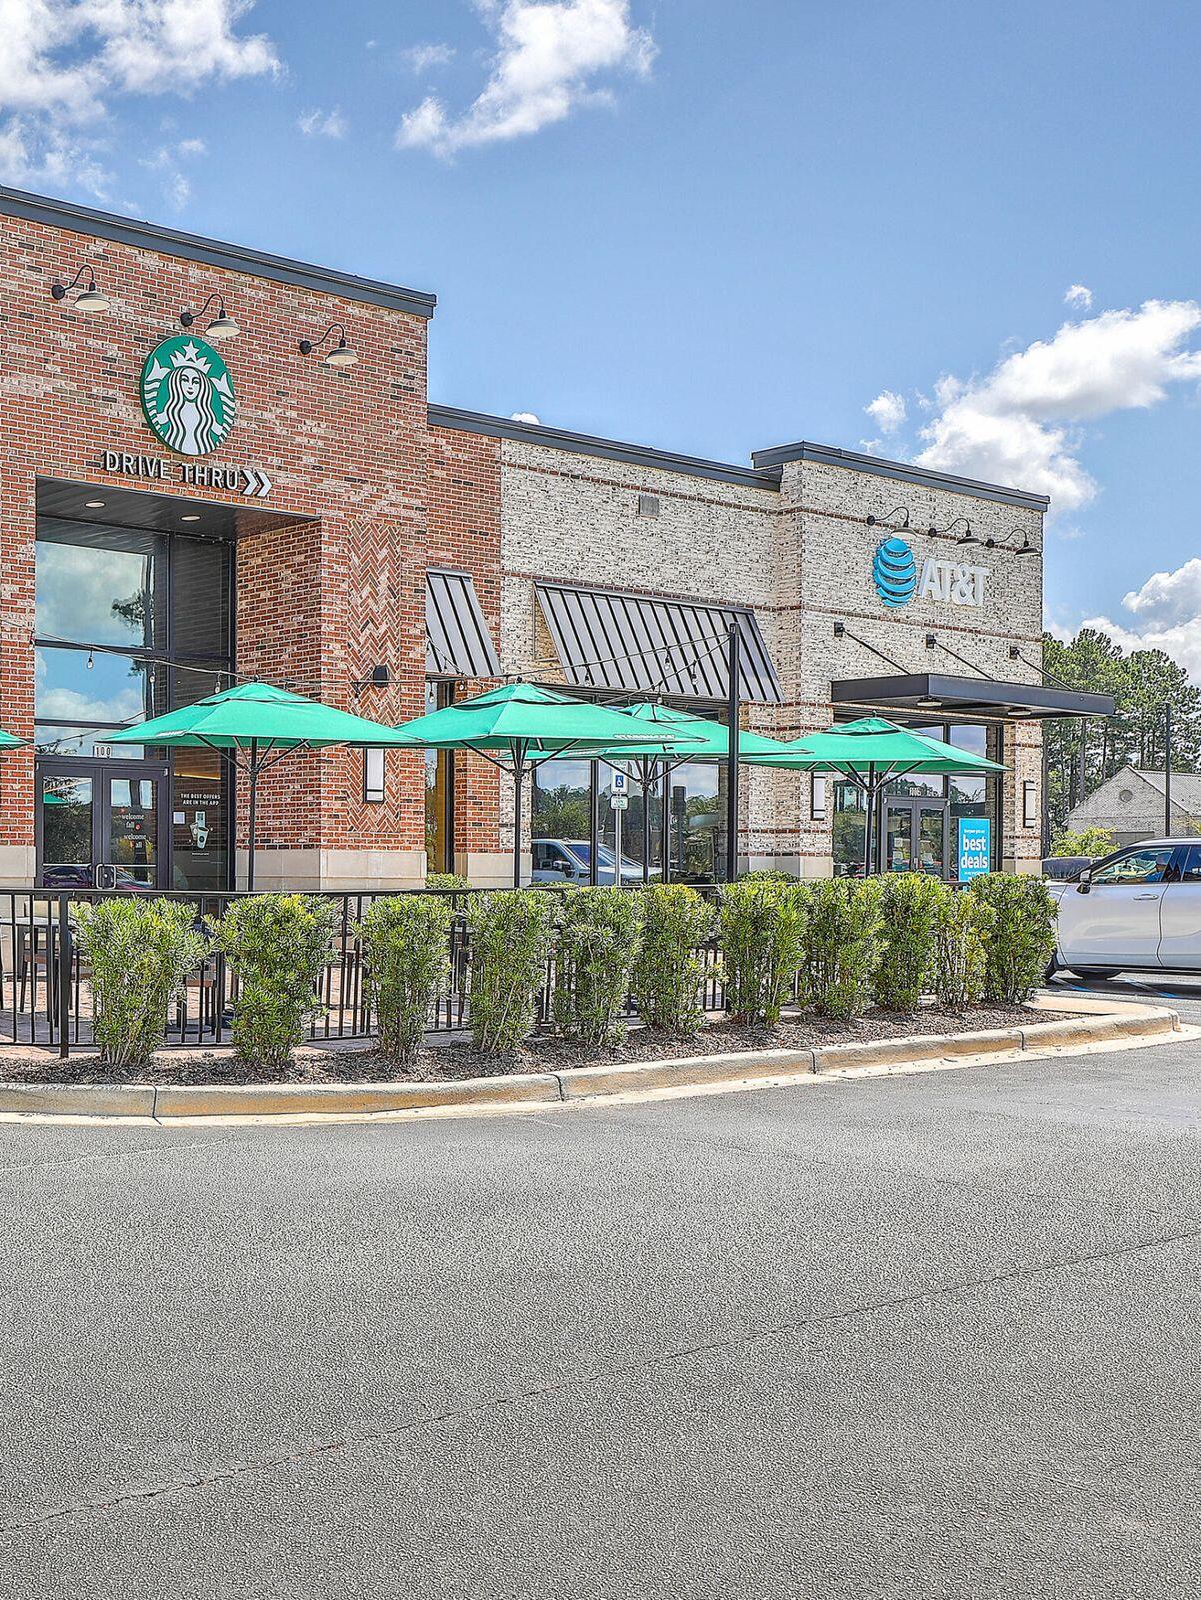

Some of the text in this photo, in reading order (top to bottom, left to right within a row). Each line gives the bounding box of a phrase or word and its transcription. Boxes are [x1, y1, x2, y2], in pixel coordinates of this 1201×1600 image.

[103, 450, 239, 489] DRIVE THRU
[918, 558, 990, 607] AT&T
[963, 834, 986, 850] best
[961, 852, 988, 868] deals
